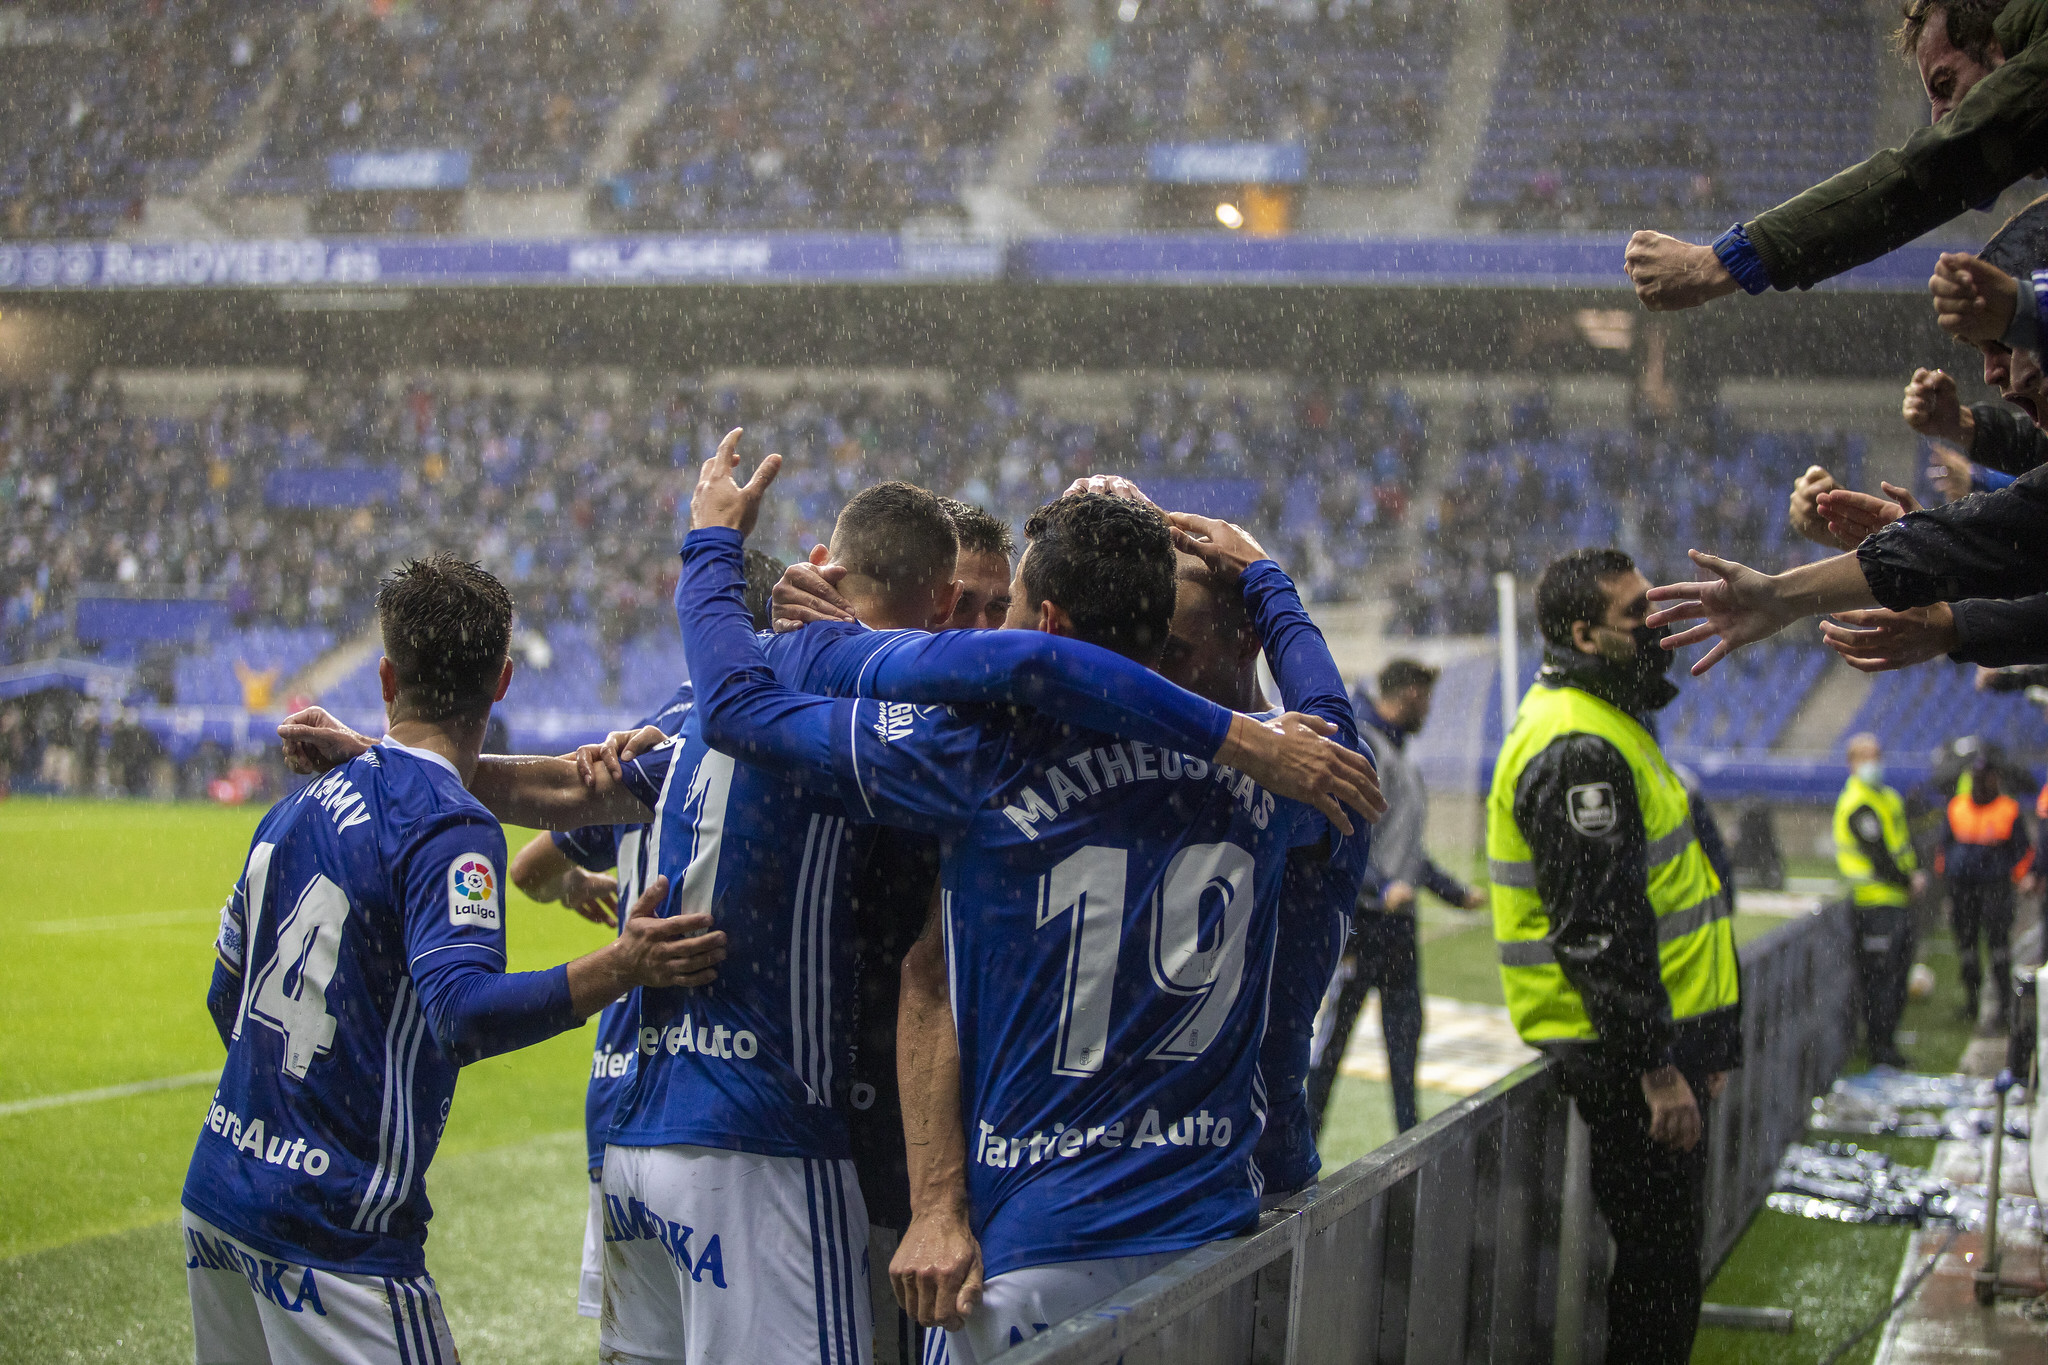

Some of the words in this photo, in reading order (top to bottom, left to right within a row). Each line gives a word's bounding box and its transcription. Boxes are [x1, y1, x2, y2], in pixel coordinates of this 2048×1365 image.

[295, 767, 372, 835] IMMY
[1002, 739, 1209, 840] MATHEUS
[455, 904, 496, 919] LaLiga
[231, 841, 350, 1084] 14
[1035, 841, 1256, 1078] 19
[676, 1013, 758, 1060] Auto
[238, 1118, 330, 1176] Auto
[975, 1119, 1126, 1169] Tartiere
[1131, 1108, 1232, 1149] Auto
